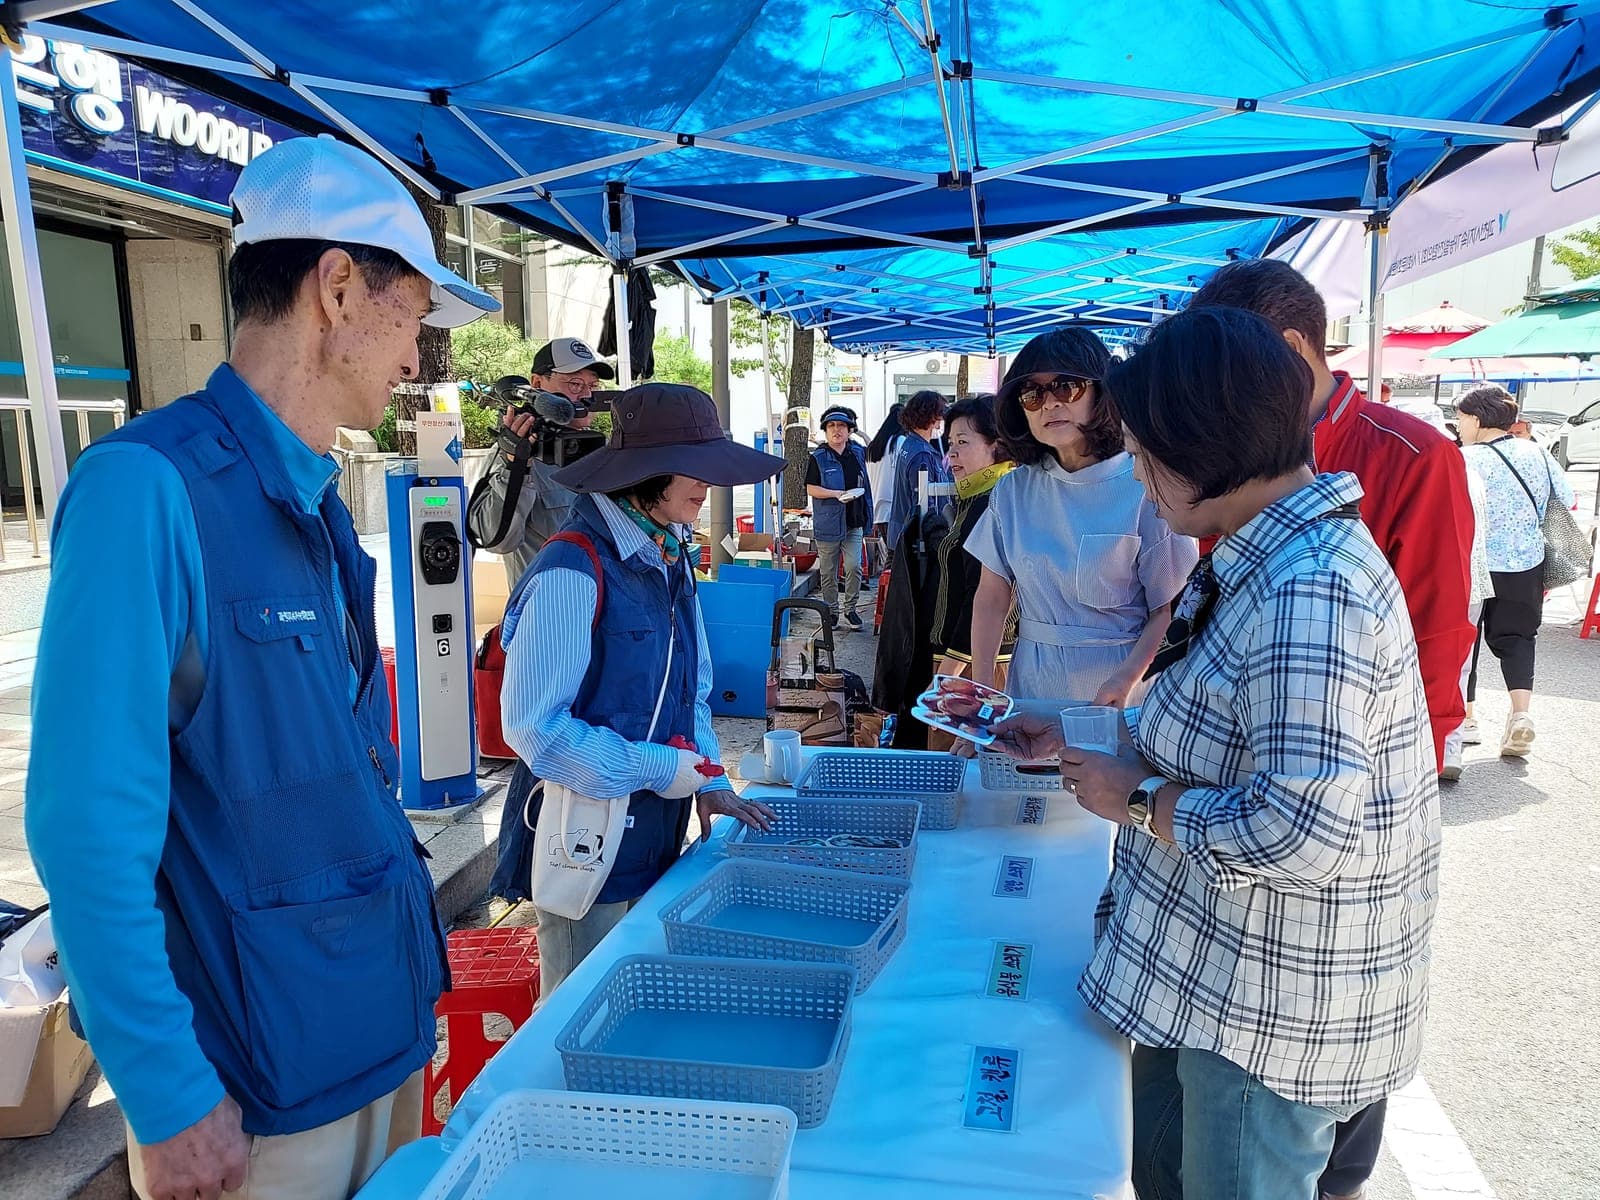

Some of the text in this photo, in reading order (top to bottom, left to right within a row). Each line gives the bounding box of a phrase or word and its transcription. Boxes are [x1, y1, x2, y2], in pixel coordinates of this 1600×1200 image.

[135, 85, 249, 167] WOORI
[438, 640, 449, 655] 6
[996, 945, 1027, 998] 음식물 쓰레기
[979, 1055, 1012, 1083] 캔류
